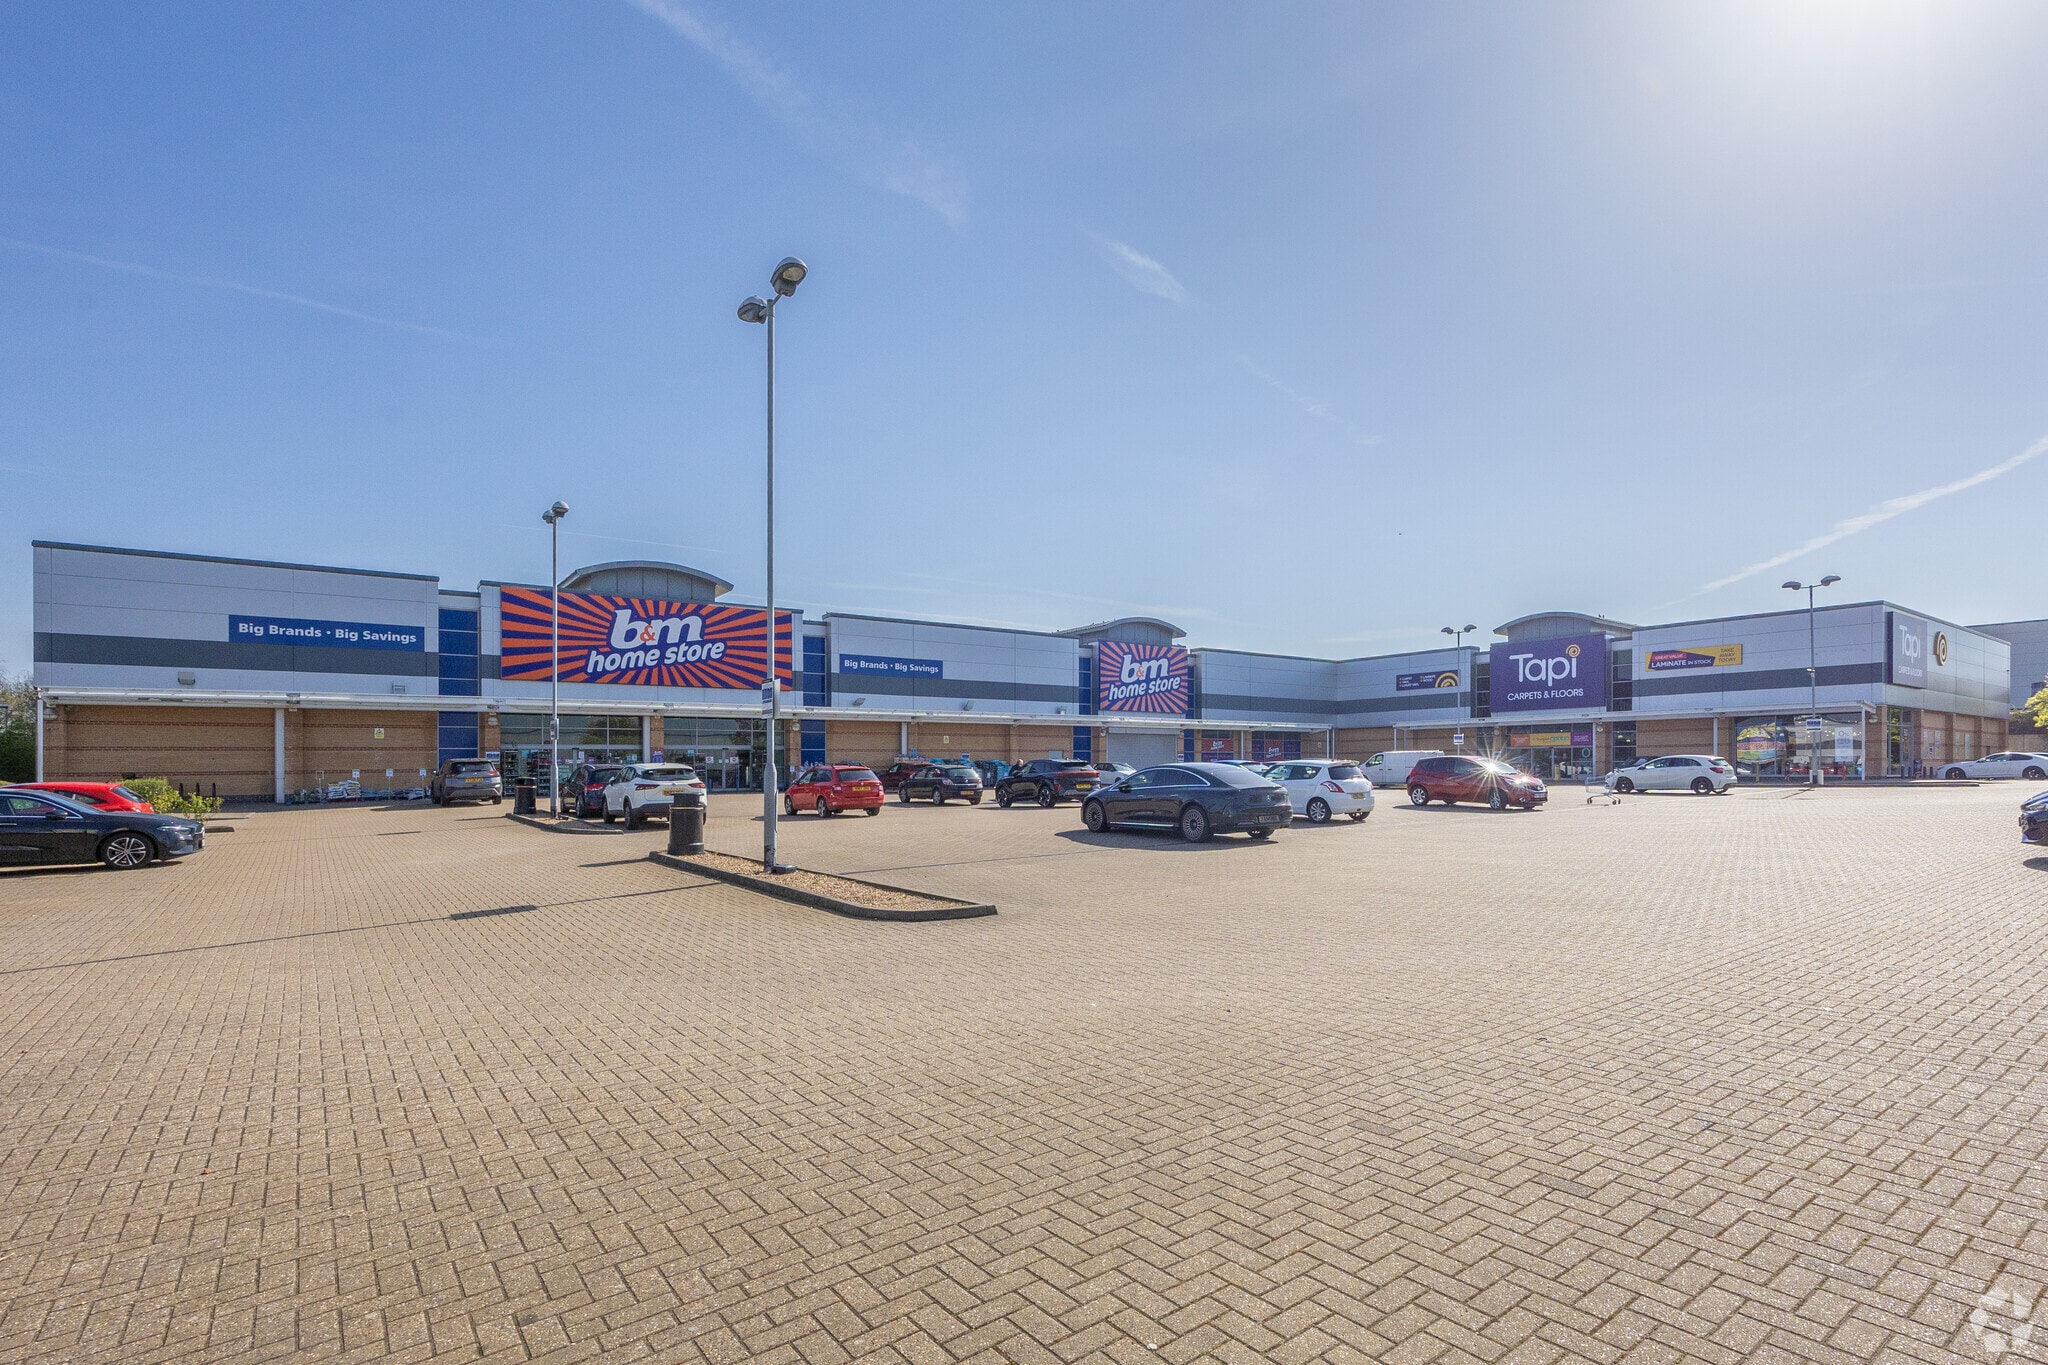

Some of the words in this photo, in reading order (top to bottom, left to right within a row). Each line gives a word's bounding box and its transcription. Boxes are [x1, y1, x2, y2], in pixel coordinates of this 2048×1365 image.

[238, 623, 264, 636] Big
[268, 625, 322, 638] Brands
[335, 628, 358, 642] Big
[362, 630, 417, 645] Savings
[1899, 625, 1920, 664] Tapi
[587, 649, 661, 673] home
[664, 642, 725, 665] store
[844, 659, 858, 669] Big
[860, 660, 888, 670] Brands
[894, 663, 908, 672] Big
[909, 663, 939, 674] Savings
[1509, 644, 1580, 687] Tapi
[1651, 660, 1687, 668] LAMINATE
[1108, 684, 1147, 701] home
[1148, 676, 1181, 694] store
[1507, 690, 1541, 701] CARPETS
[1543, 690, 1550, 699] &
[1551, 688, 1584, 698] FLOORS
